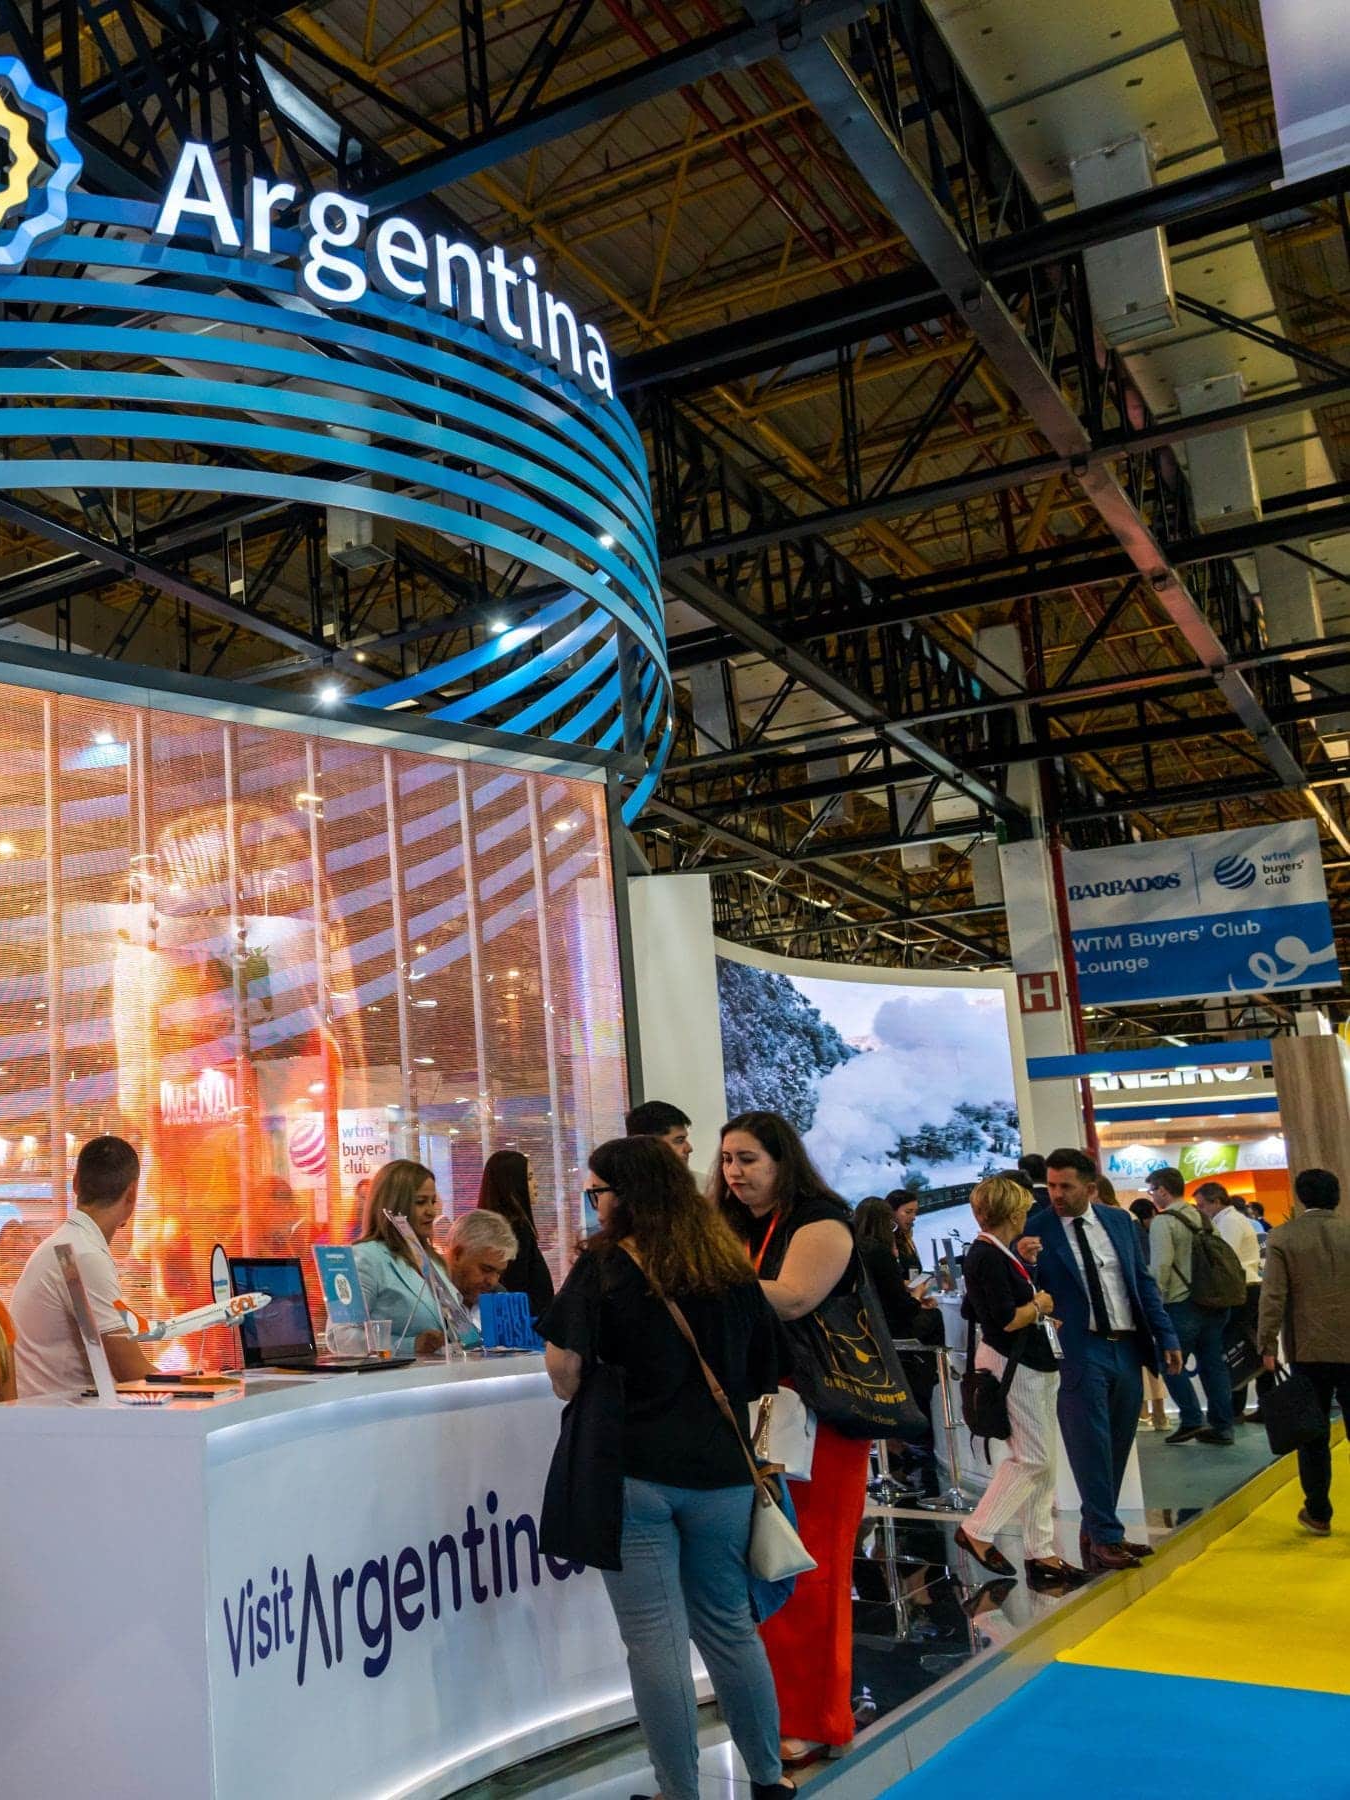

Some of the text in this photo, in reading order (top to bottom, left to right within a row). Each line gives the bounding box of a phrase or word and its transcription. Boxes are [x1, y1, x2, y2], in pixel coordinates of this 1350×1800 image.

[154, 141, 615, 400] Argentina
[1261, 852, 1291, 861] wtm
[1262, 859, 1304, 875] buyers'
[1068, 872, 1180, 901] BARBADOS
[1265, 874, 1291, 886] club
[1072, 933, 1123, 953] WTM
[1212, 919, 1262, 938] Club
[1076, 956, 1149, 975] Lounge
[1021, 976, 1055, 1010] H
[342, 1125, 374, 1138] wtm
[342, 1140, 388, 1161] buyers'
[345, 1159, 371, 1174] club
[230, 1296, 257, 1316] GOL
